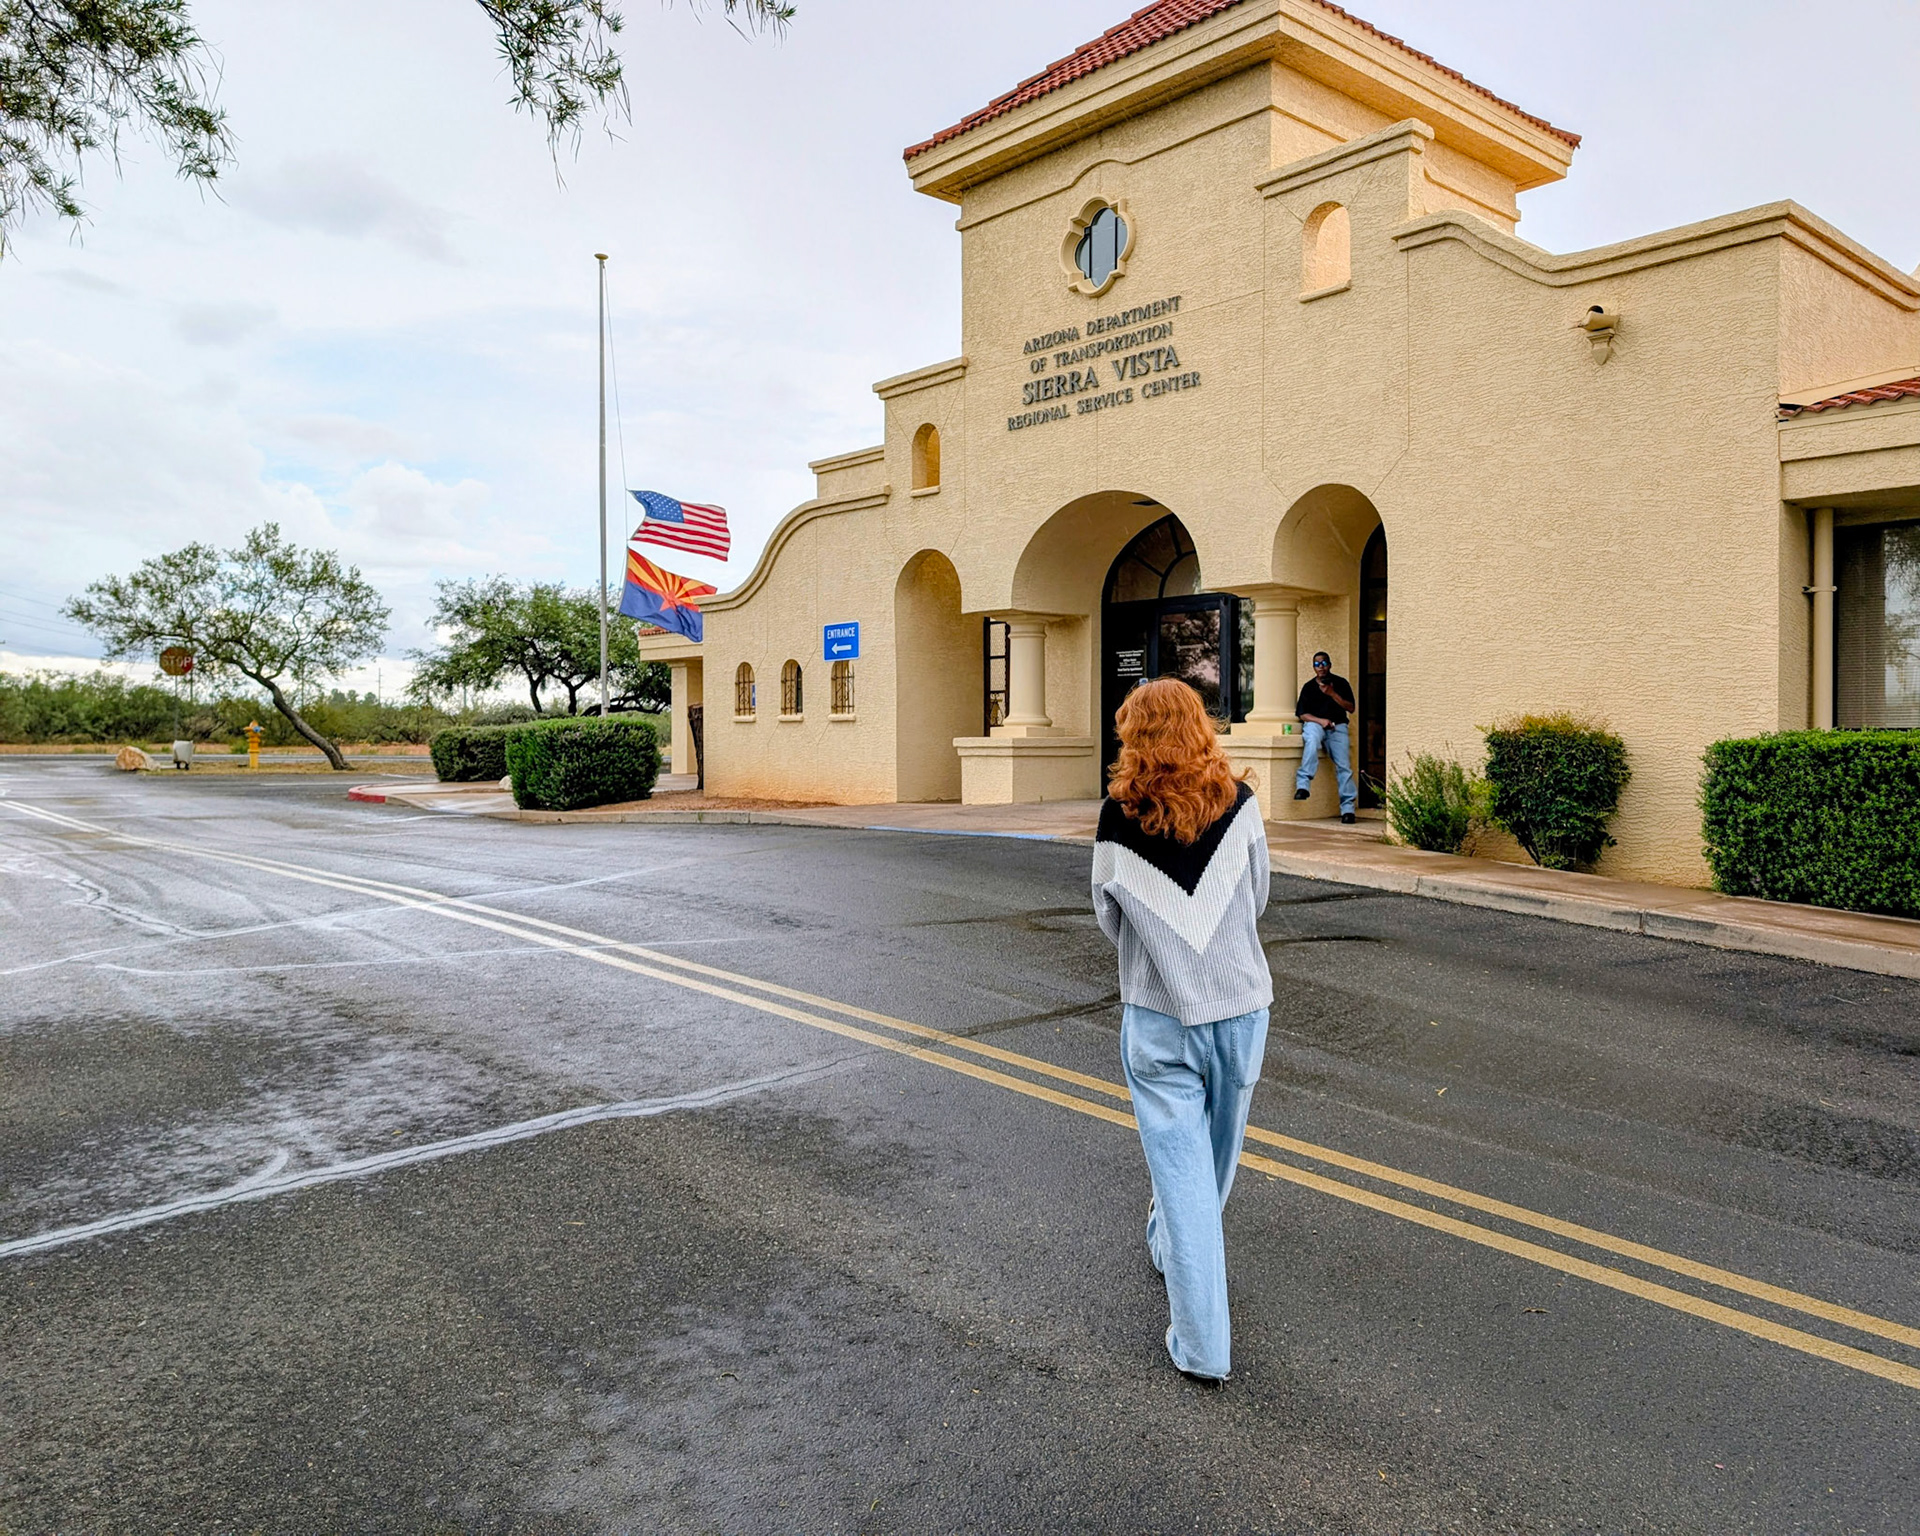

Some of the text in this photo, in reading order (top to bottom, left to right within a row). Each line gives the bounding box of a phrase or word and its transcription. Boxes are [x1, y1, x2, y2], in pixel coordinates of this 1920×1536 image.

[1023, 295, 1181, 354] ARIZONA DEPARTMENT
[1030, 321, 1173, 373] OF TRANSPORTATION
[1007, 371, 1201, 431] REGIONAL SERVICE CENTER
[1022, 344, 1181, 405] SIERRA VISTA
[827, 627, 855, 640] ENTRANCE
[162, 656, 191, 667] STOP
